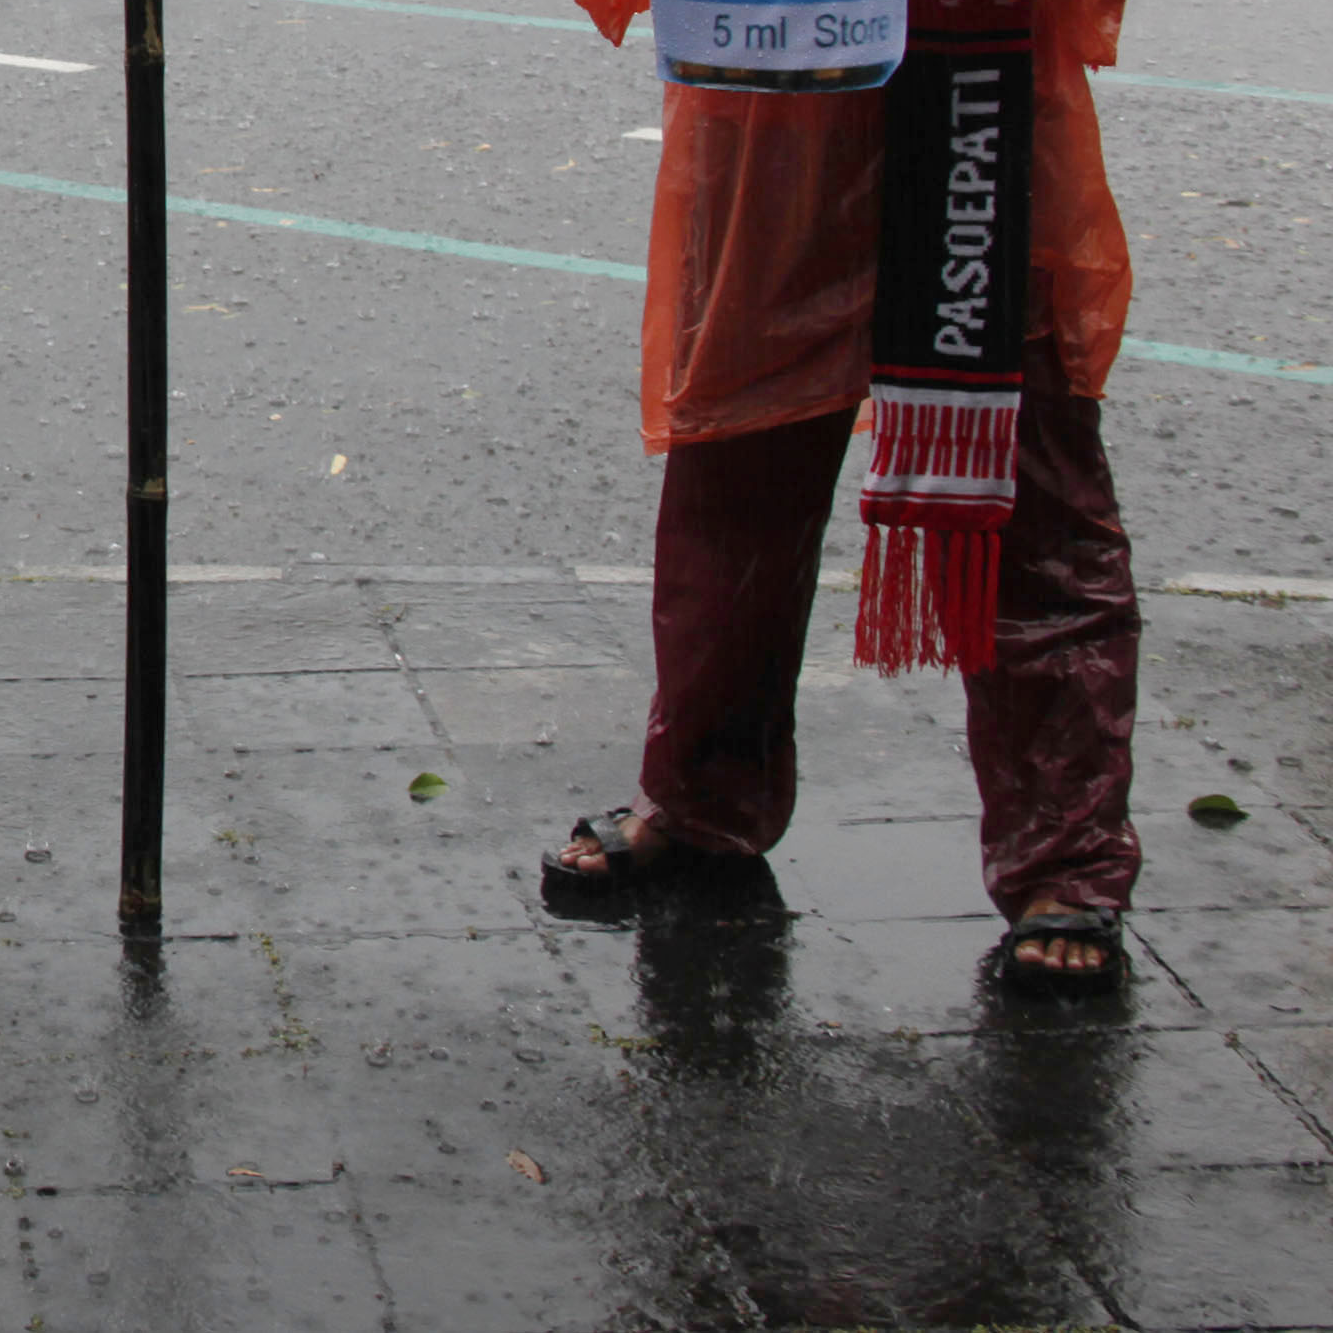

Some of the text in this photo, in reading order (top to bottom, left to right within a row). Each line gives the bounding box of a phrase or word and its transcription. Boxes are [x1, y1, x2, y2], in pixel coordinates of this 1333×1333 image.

[712, 13, 733, 48] 5
[745, 14, 787, 50] ml
[933, 68, 1001, 358] PASOEPATI
